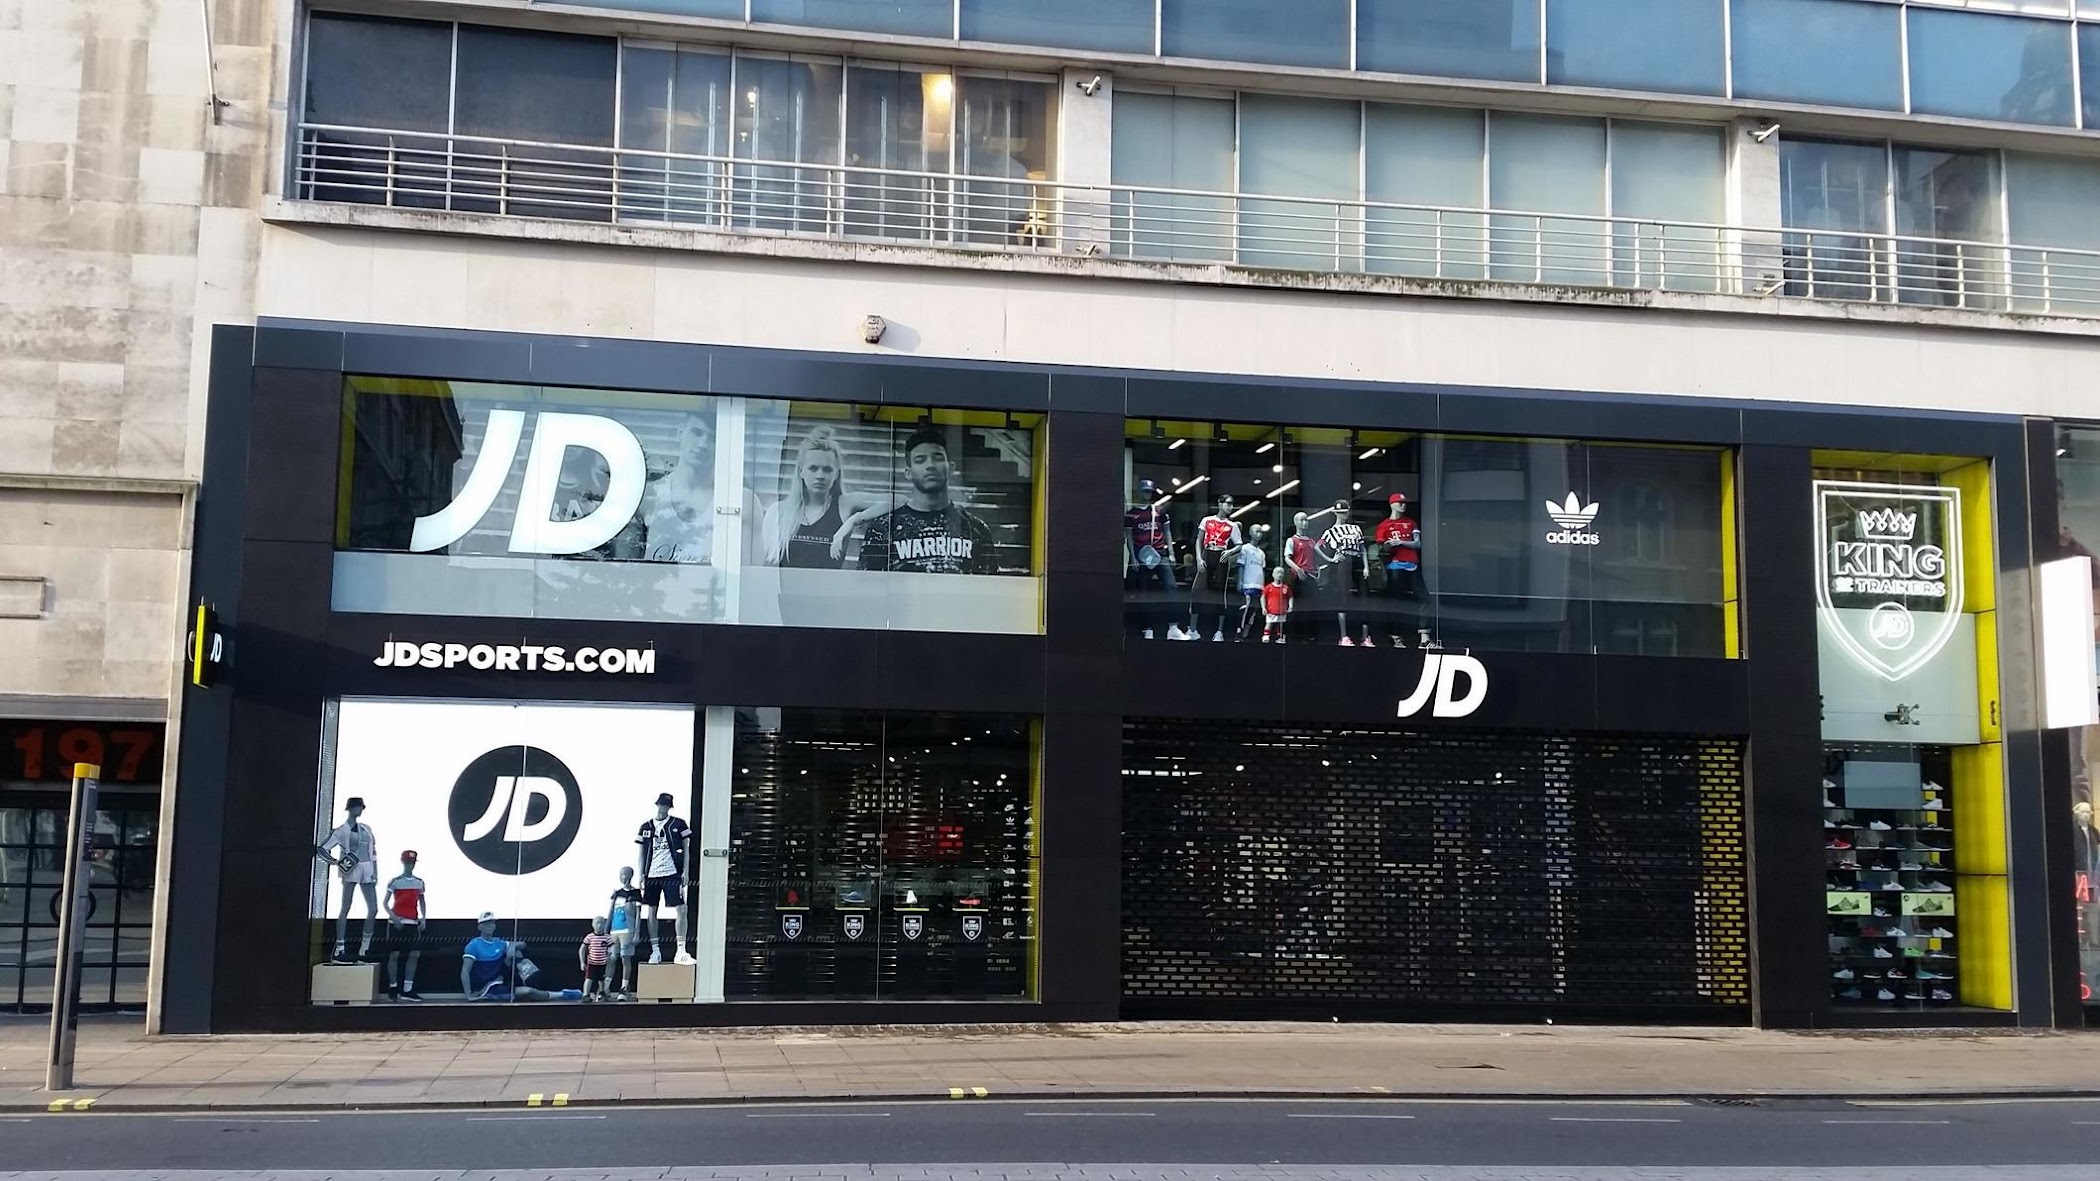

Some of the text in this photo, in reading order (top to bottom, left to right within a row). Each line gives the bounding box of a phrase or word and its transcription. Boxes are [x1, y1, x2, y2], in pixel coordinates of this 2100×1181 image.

[410, 409, 647, 554] JD
[894, 536, 972, 560] WARRIOR
[1546, 529, 1600, 545] adidas
[1834, 541, 1945, 580] KING
[1855, 577, 1946, 597] TRAINERS
[373, 641, 656, 674] JDSPORTS.COM
[1397, 653, 1489, 718] JD
[15, 726, 155, 781] 197
[463, 775, 568, 843] JD
